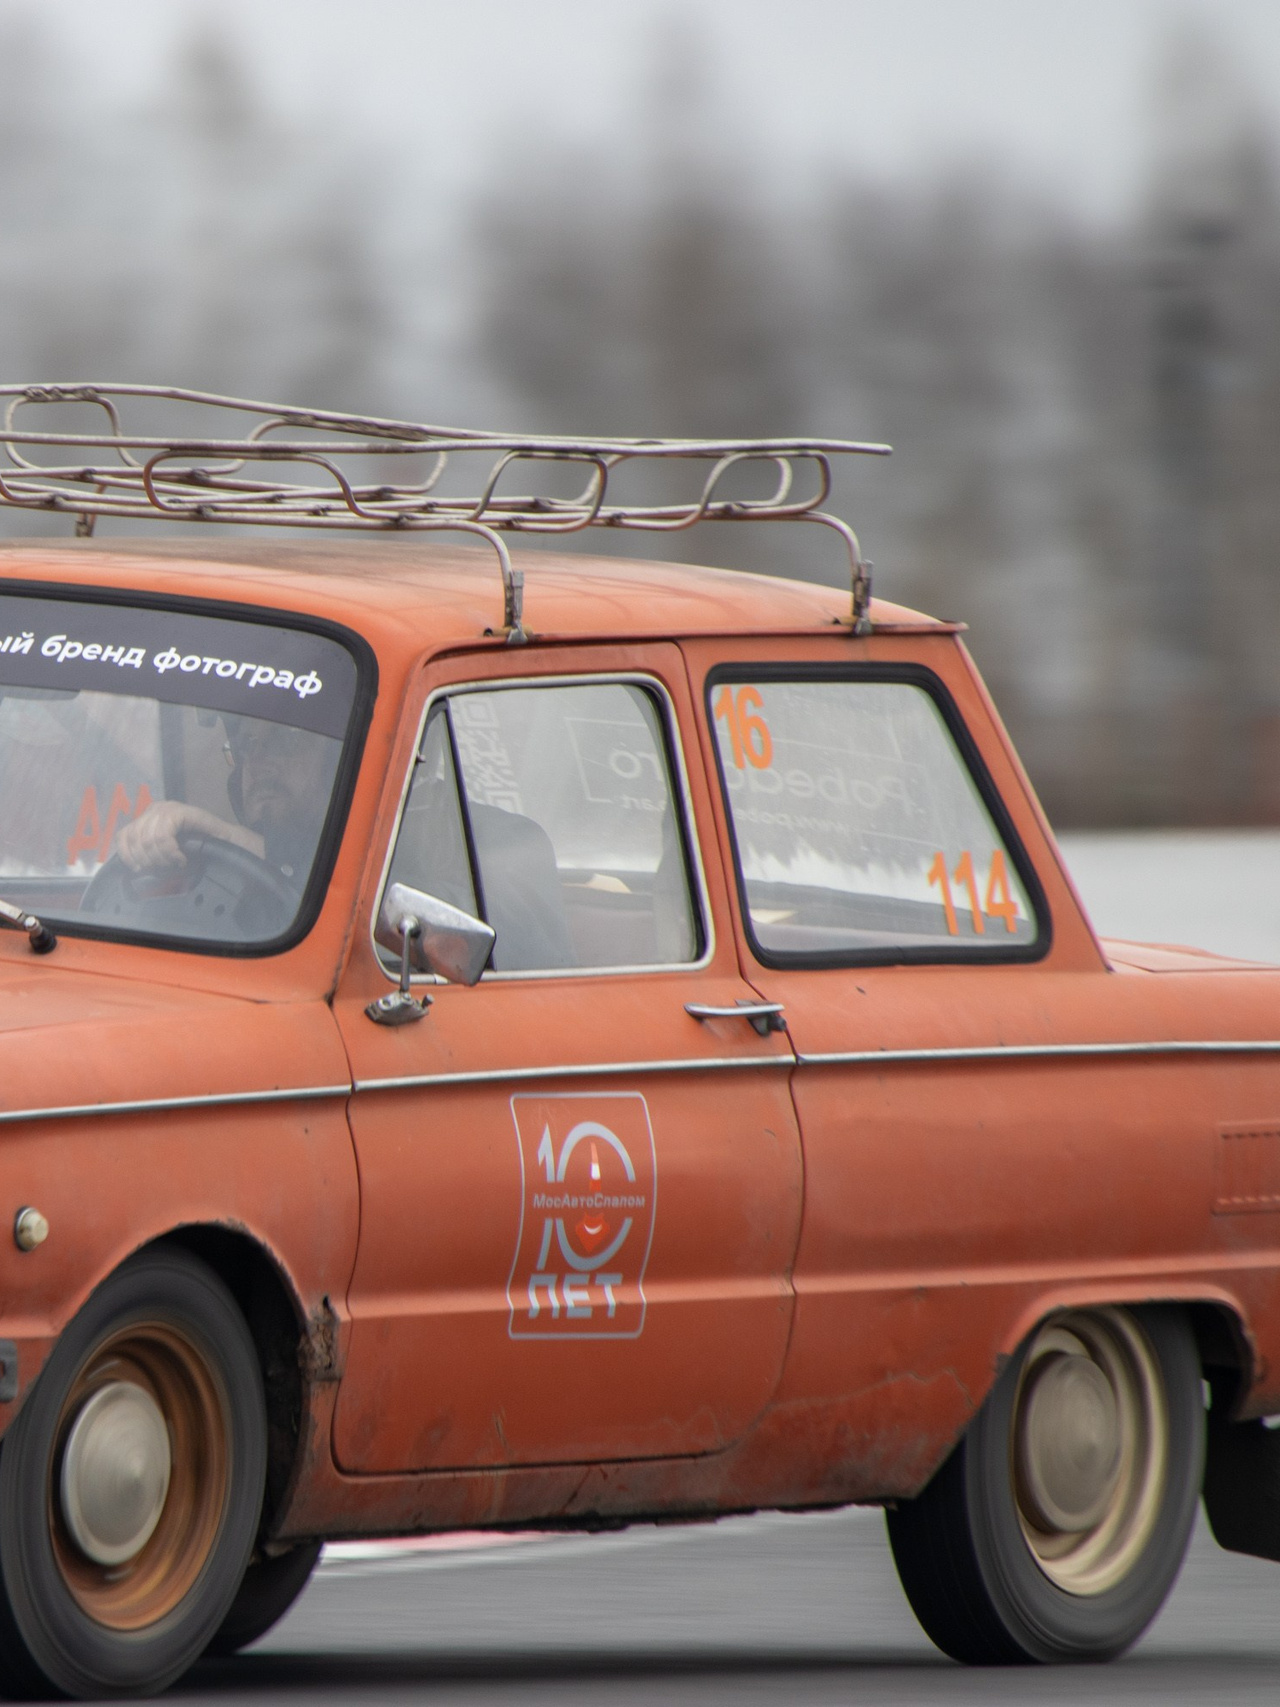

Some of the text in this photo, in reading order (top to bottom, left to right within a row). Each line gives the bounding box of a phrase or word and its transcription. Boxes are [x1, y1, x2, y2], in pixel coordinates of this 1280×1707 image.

[40, 634, 147, 668] бренд
[152, 646, 324, 699] фотограф
[714, 685, 773, 770] 16
[927, 849, 1019, 936] 114
